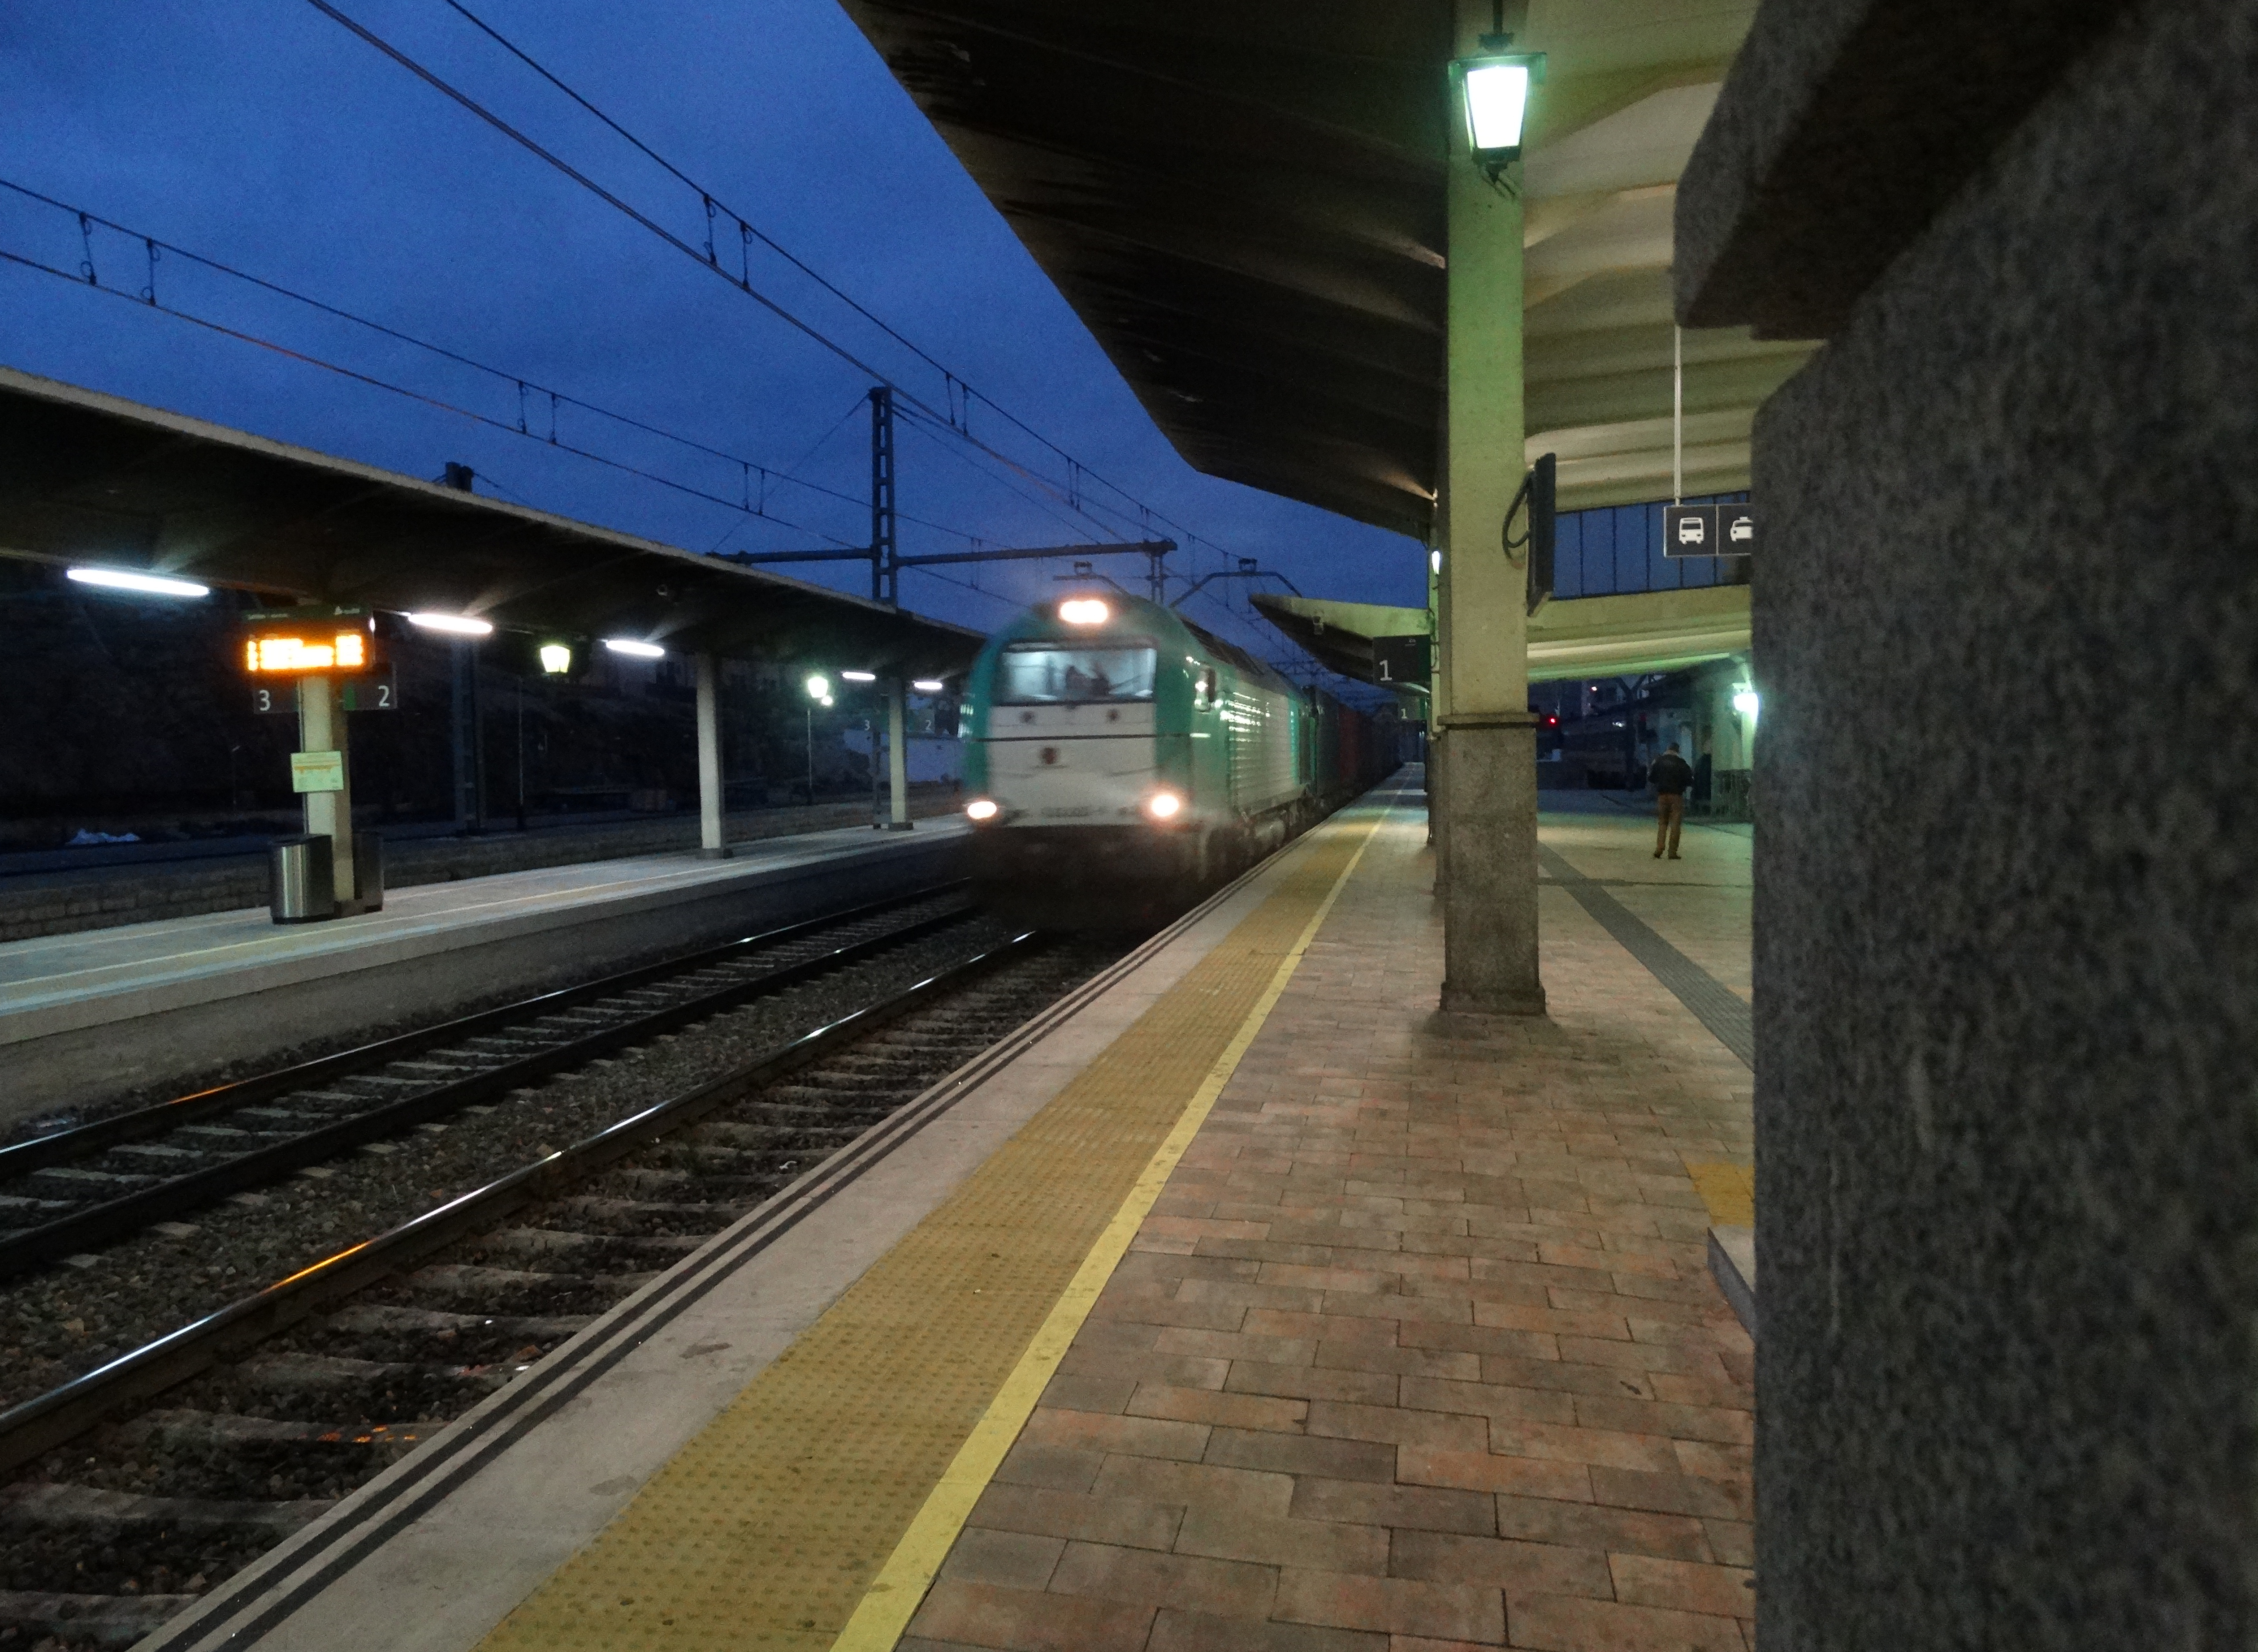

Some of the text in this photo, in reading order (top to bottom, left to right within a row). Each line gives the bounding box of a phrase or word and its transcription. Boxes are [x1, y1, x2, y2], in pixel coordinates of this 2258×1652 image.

[1380, 660, 1392, 681] 1
[260, 689, 271, 712] 3
[378, 685, 390, 707] 2
[1401, 708, 1407, 719] 1
